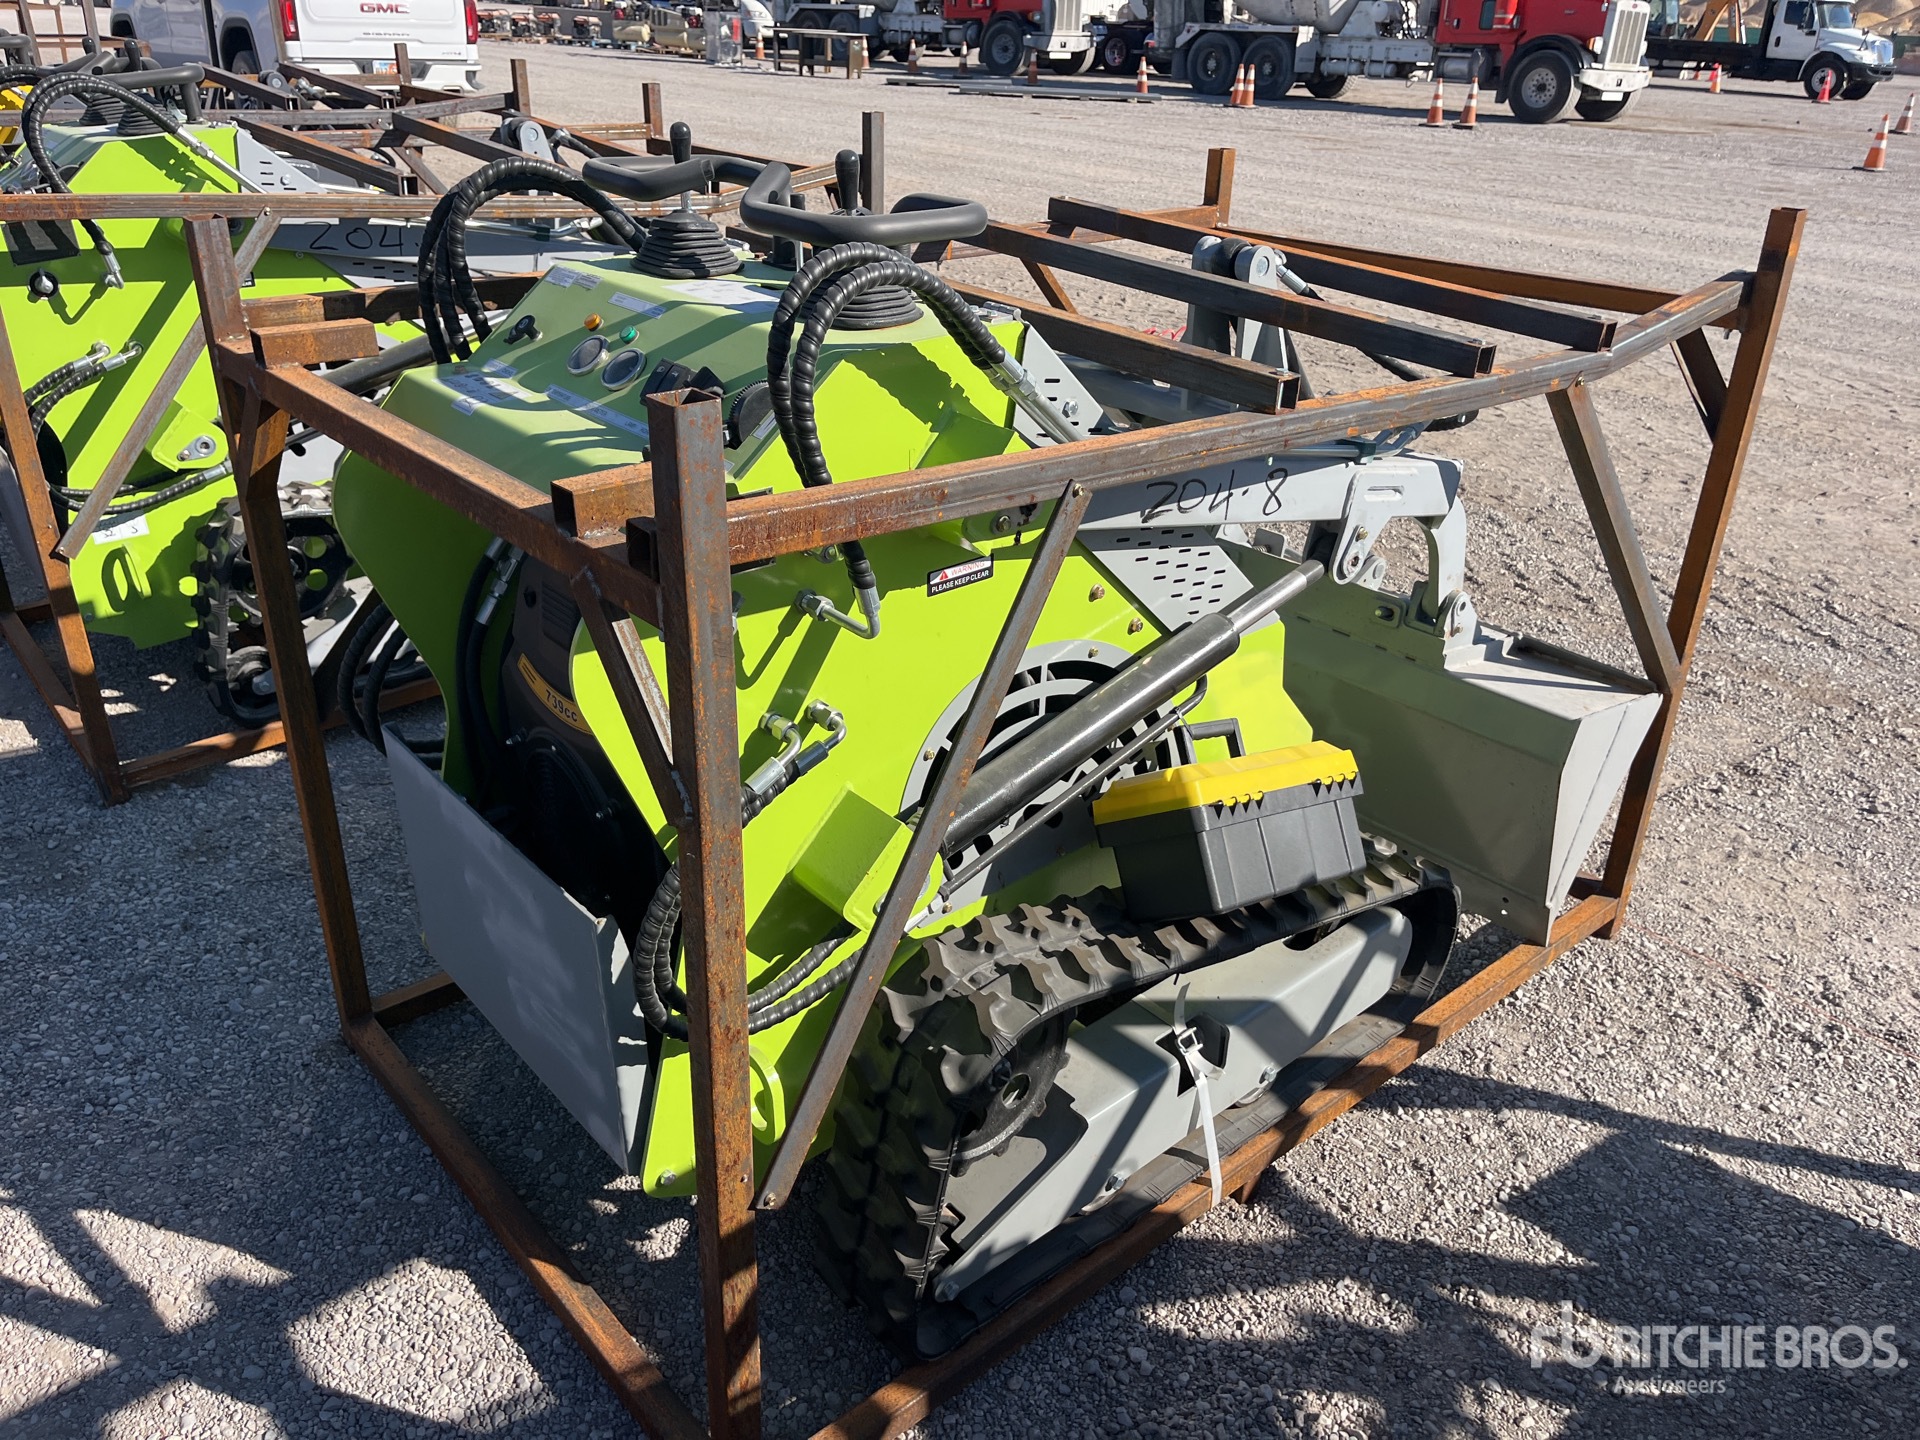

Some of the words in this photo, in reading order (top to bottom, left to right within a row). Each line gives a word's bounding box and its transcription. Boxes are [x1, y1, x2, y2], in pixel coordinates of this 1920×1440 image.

[360, 3, 410, 14] GMC
[951, 561, 985, 576] WARNING
[931, 580, 954, 593] PLEASE
[954, 575, 971, 586] KEEP
[970, 570, 990, 581] CLEAR
[545, 689, 578, 722] 739cc
